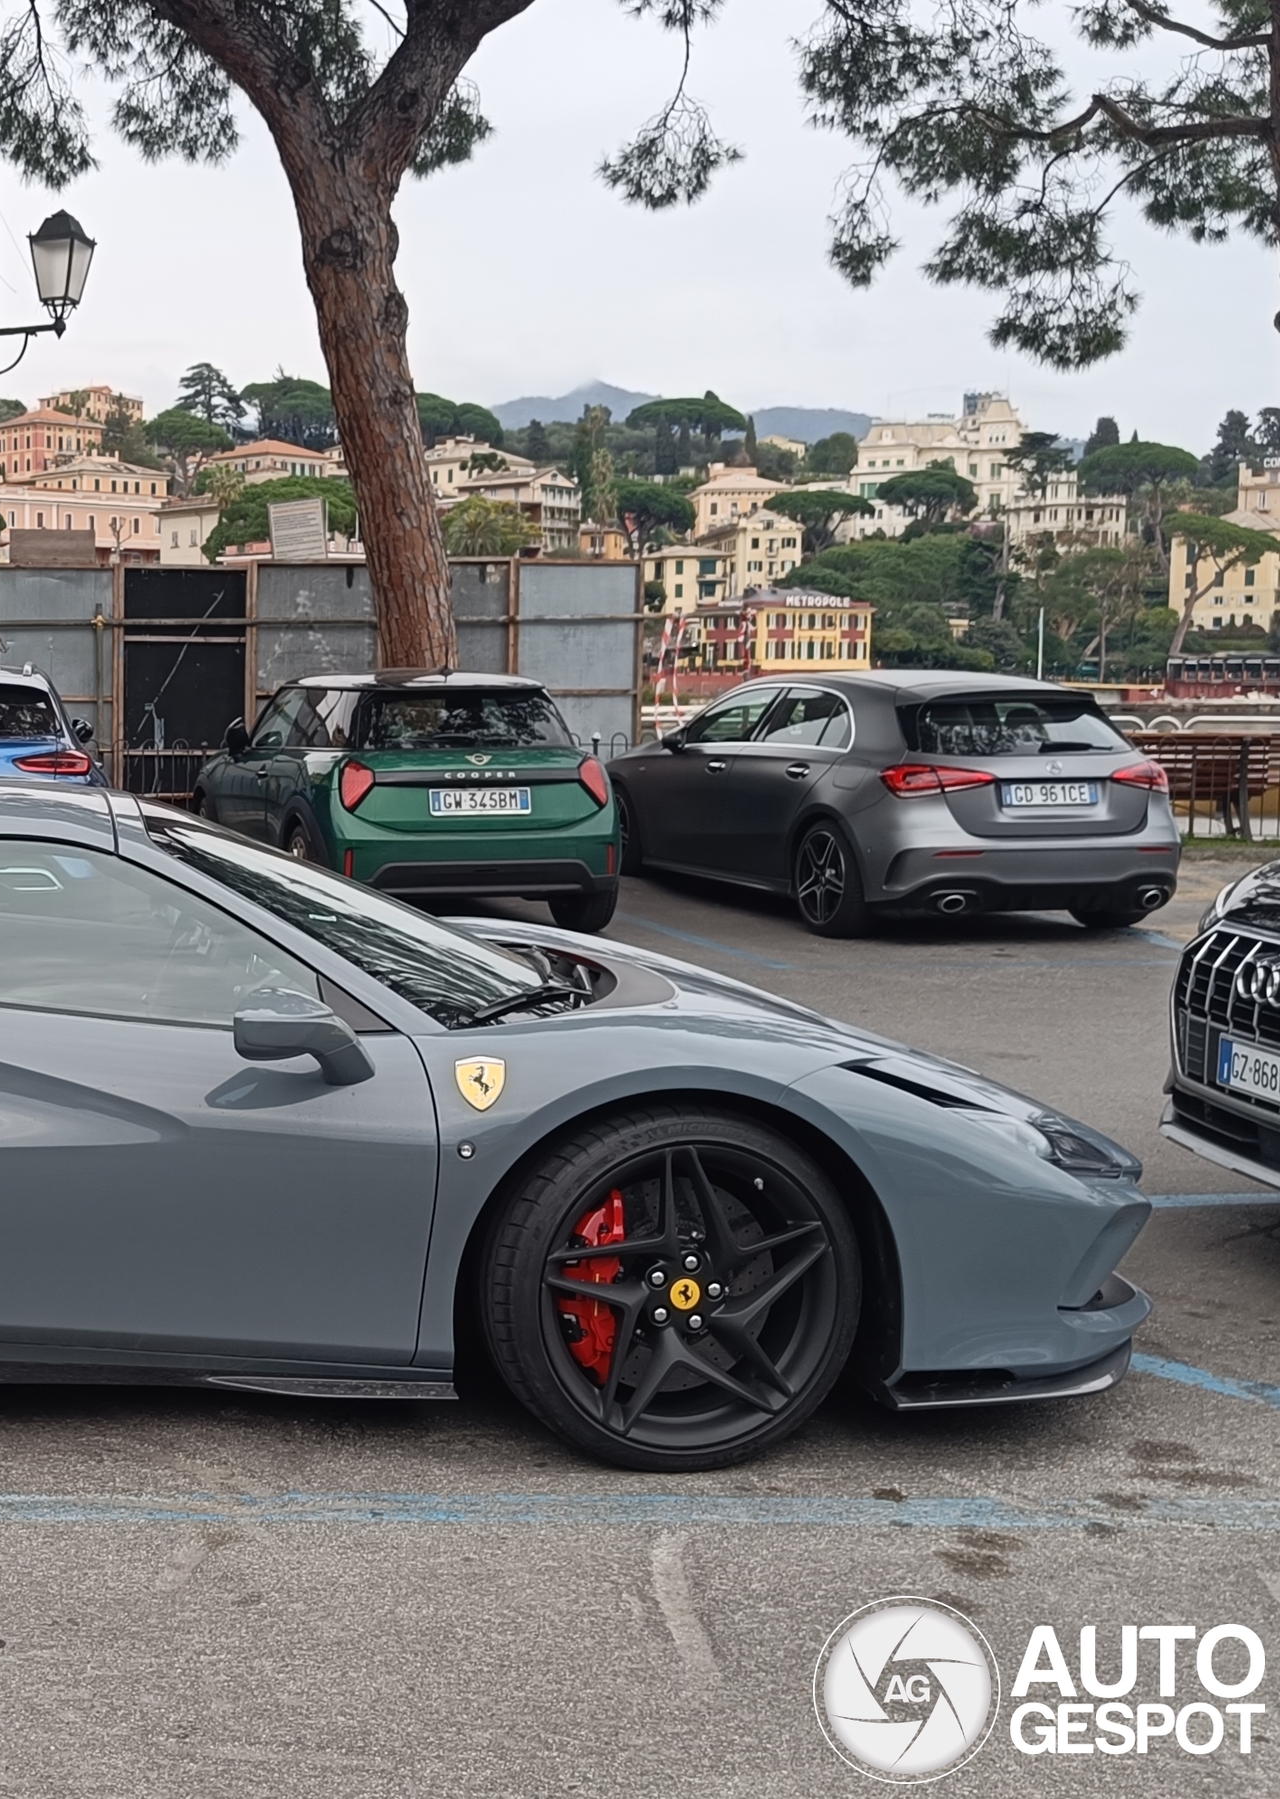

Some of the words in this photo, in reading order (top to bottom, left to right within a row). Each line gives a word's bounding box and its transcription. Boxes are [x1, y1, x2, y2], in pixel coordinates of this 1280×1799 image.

[786, 595, 850, 608] METROPOLE
[444, 771, 516, 779] COOPER
[443, 792, 462, 809] GW
[468, 791, 518, 809] 345BM
[1014, 785, 1034, 803] GD
[1040, 785, 1088, 803] 961CE
[1232, 1052, 1249, 1083] GZ
[1253, 1058, 1280, 1093] 868
